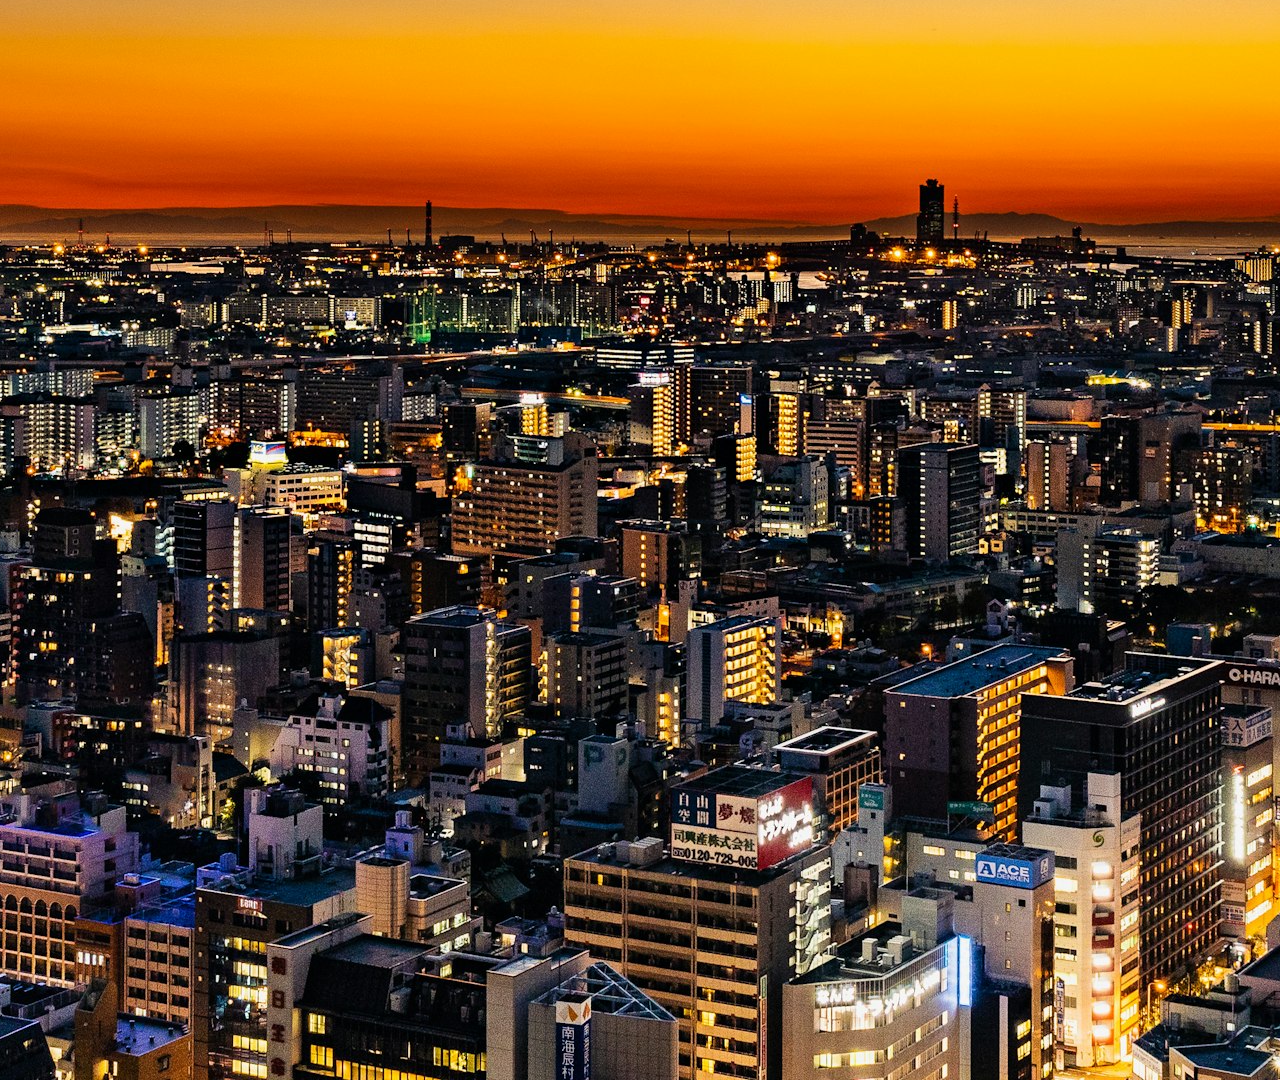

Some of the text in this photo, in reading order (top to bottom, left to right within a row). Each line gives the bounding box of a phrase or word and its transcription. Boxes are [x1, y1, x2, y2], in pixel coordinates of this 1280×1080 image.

[997, 863, 1031, 877] ACE
[996, 873, 1031, 883] DENKEN
[561, 1026, 576, 1080] 南海辰村
